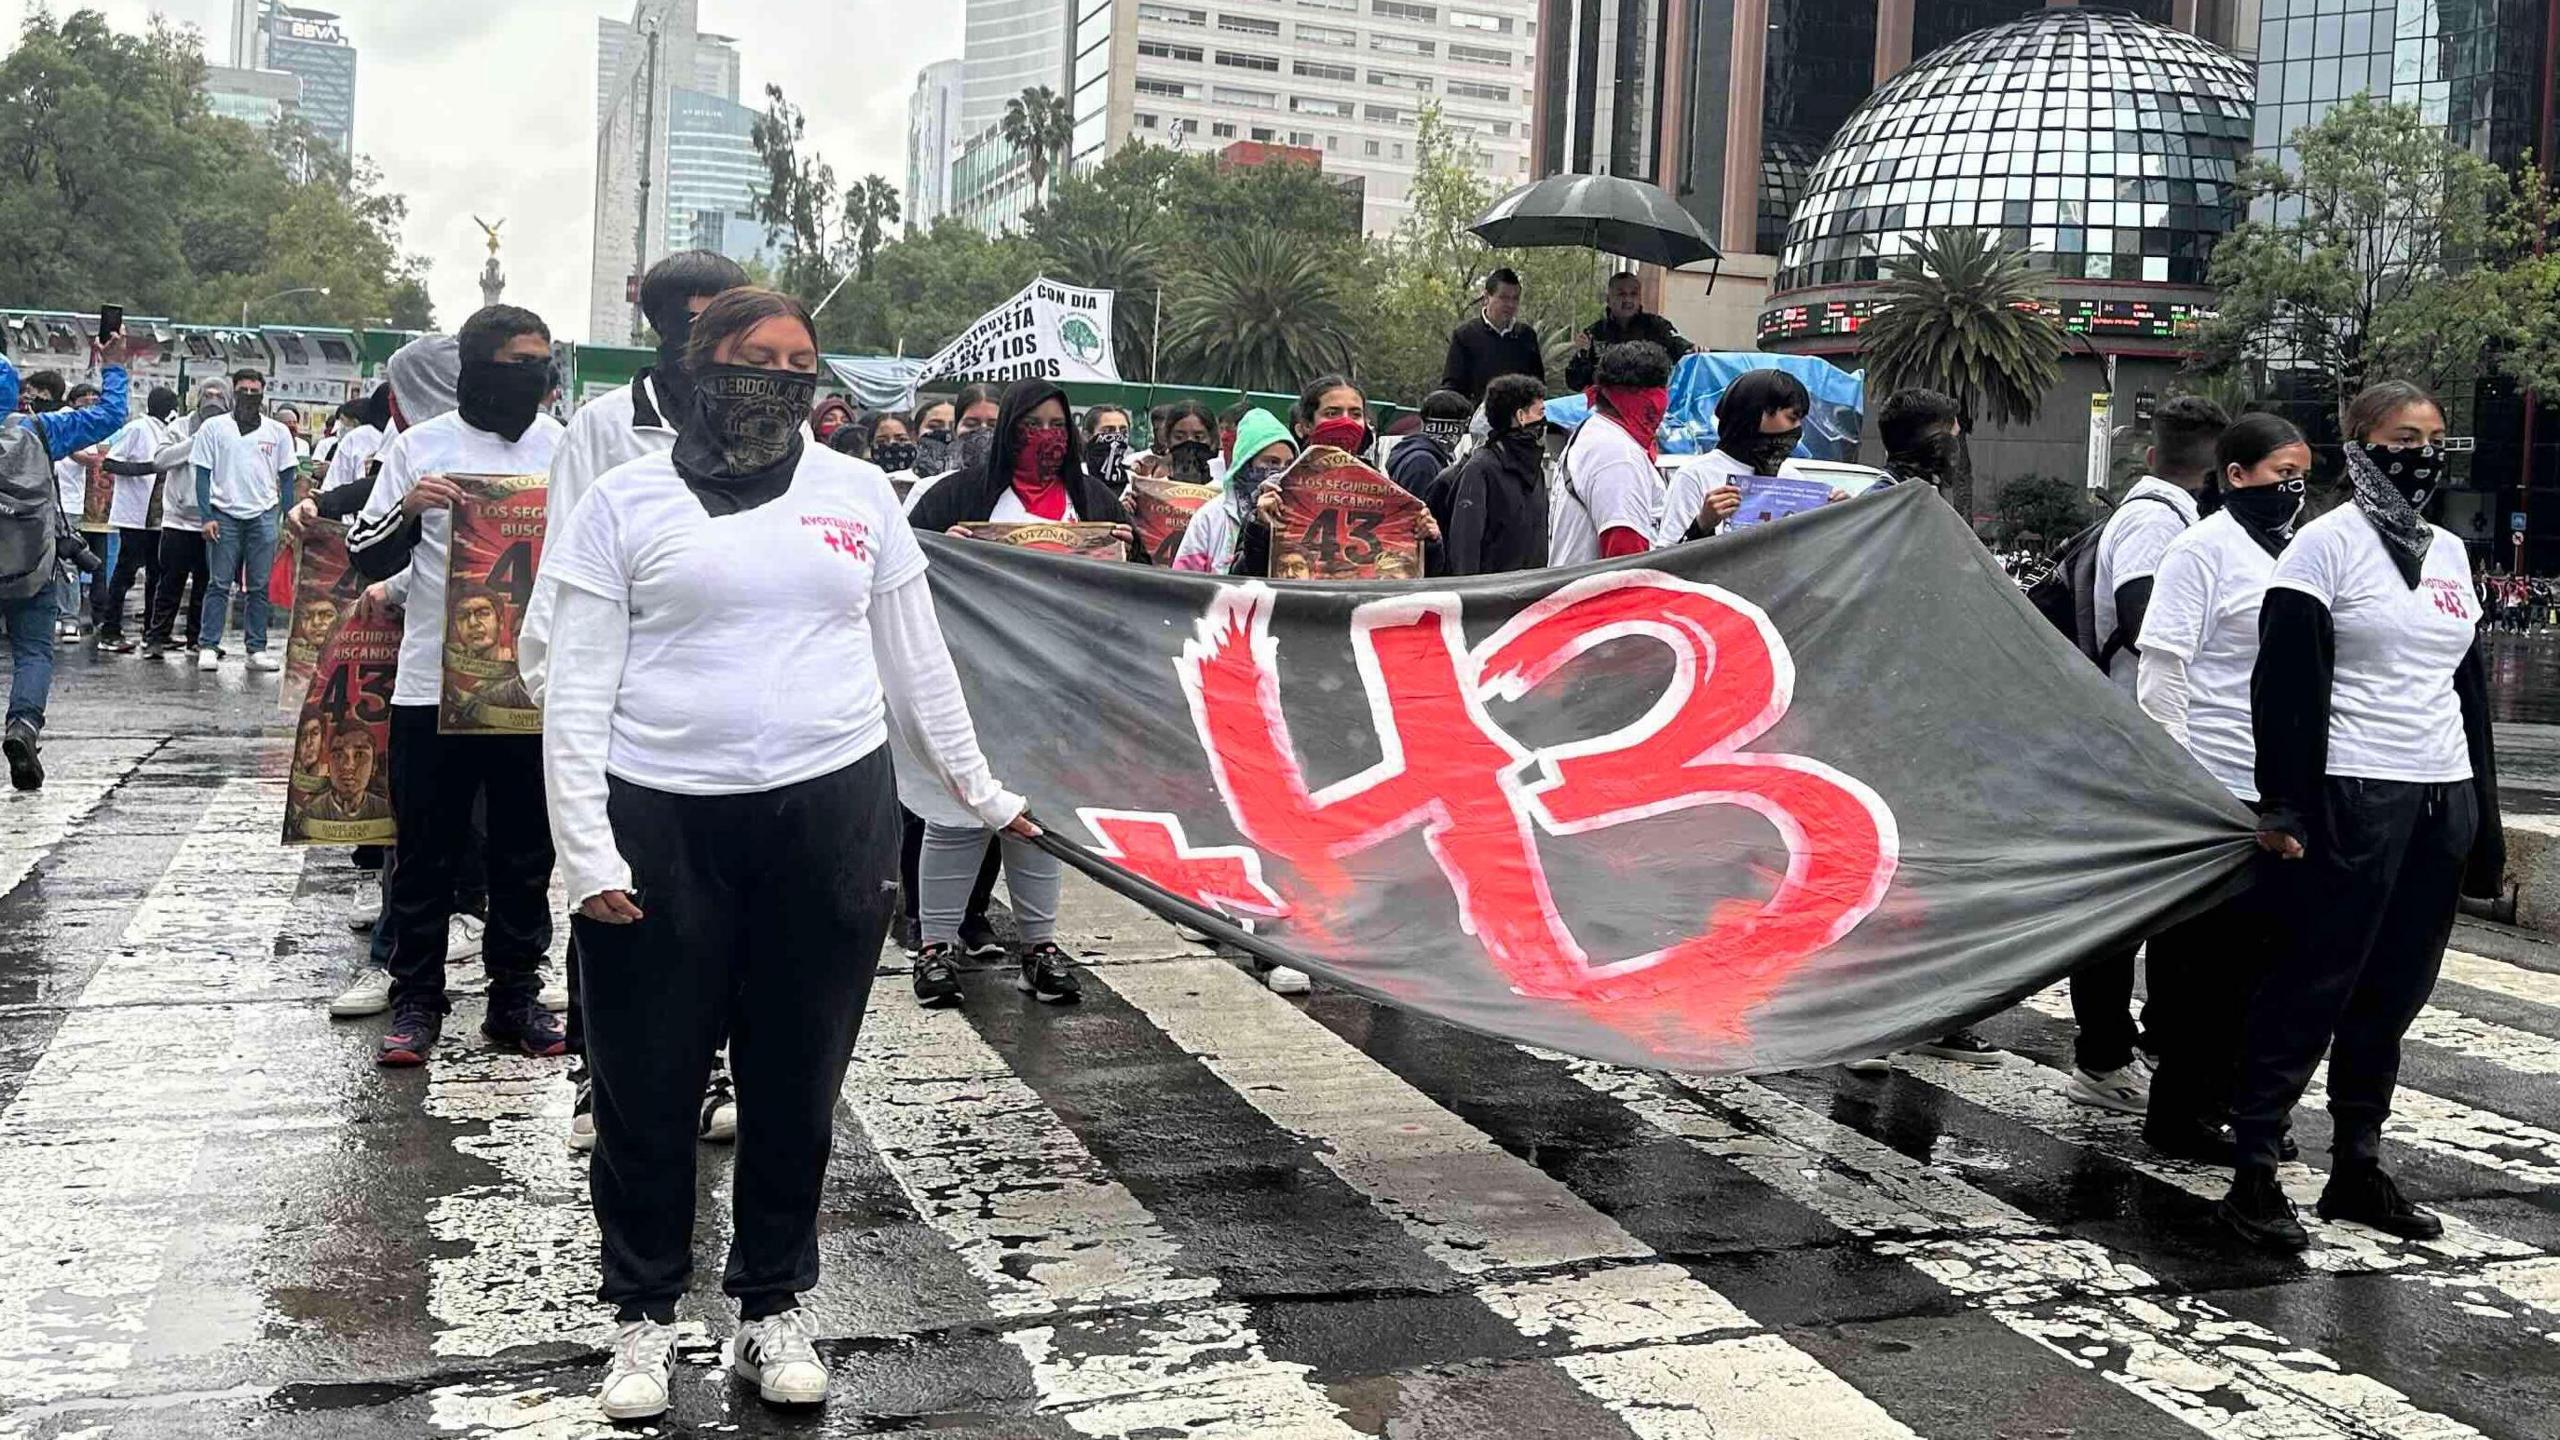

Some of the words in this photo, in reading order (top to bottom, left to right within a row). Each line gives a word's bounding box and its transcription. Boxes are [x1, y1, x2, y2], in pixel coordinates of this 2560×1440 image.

[292, 22, 338, 40] BBVA
[1037, 284, 1066, 305] CON
[1071, 293, 1097, 310] DÍA
[1002, 333, 1038, 360] LOS
[1298, 477, 1322, 489] LOS
[1326, 480, 1404, 496] SEGUIREMOS
[1316, 491, 1384, 507] BUSCANDO
[476, 504, 508, 520] LOS
[512, 506, 548, 520] SEG
[1300, 507, 1388, 565] 43
[2433, 590, 2468, 619] +43
[320, 663, 398, 727] 43
[1075, 566, 1902, 1010] +43
